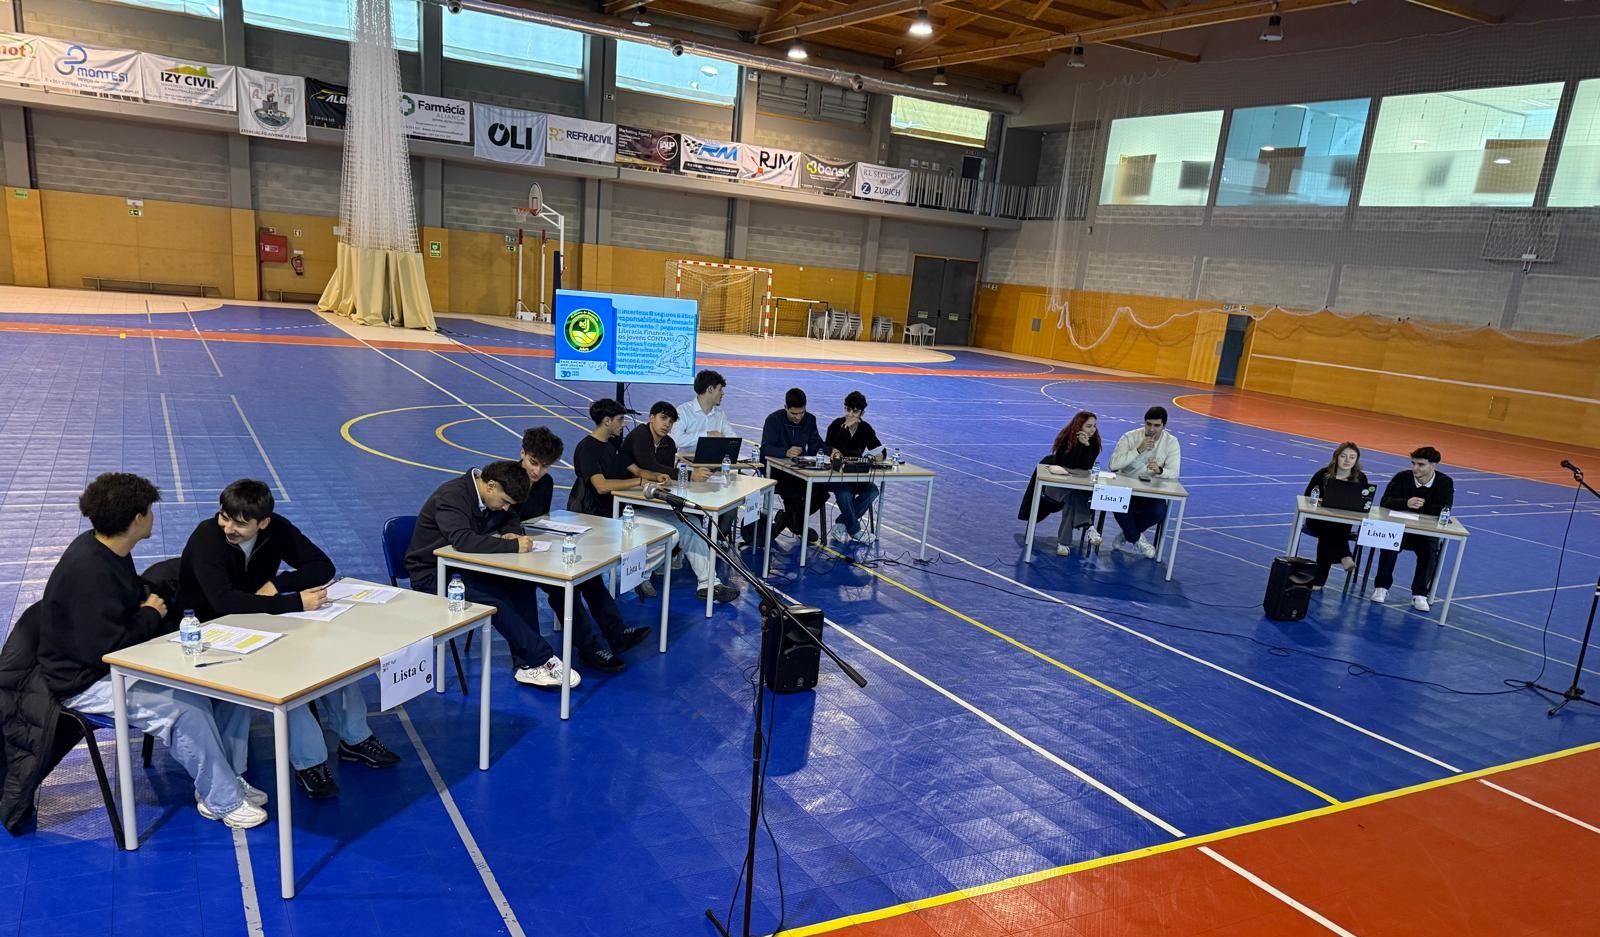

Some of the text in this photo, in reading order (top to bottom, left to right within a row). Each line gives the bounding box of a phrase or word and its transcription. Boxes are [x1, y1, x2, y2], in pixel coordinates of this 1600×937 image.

[160, 72, 182, 84] IZY
[185, 76, 218, 89] CIVIL
[418, 100, 466, 115] Farmácia
[488, 122, 532, 150] OLI
[566, 129, 614, 146] REFRACIVIL
[760, 151, 793, 171] RJM
[874, 186, 901, 197] ZURICH
[618, 316, 665, 324] esponsabilidade
[1100, 494, 1117, 502] Lista
[1367, 529, 1386, 538] Lista
[626, 565, 638, 577] Lista
[393, 660, 427, 684] Lista C
